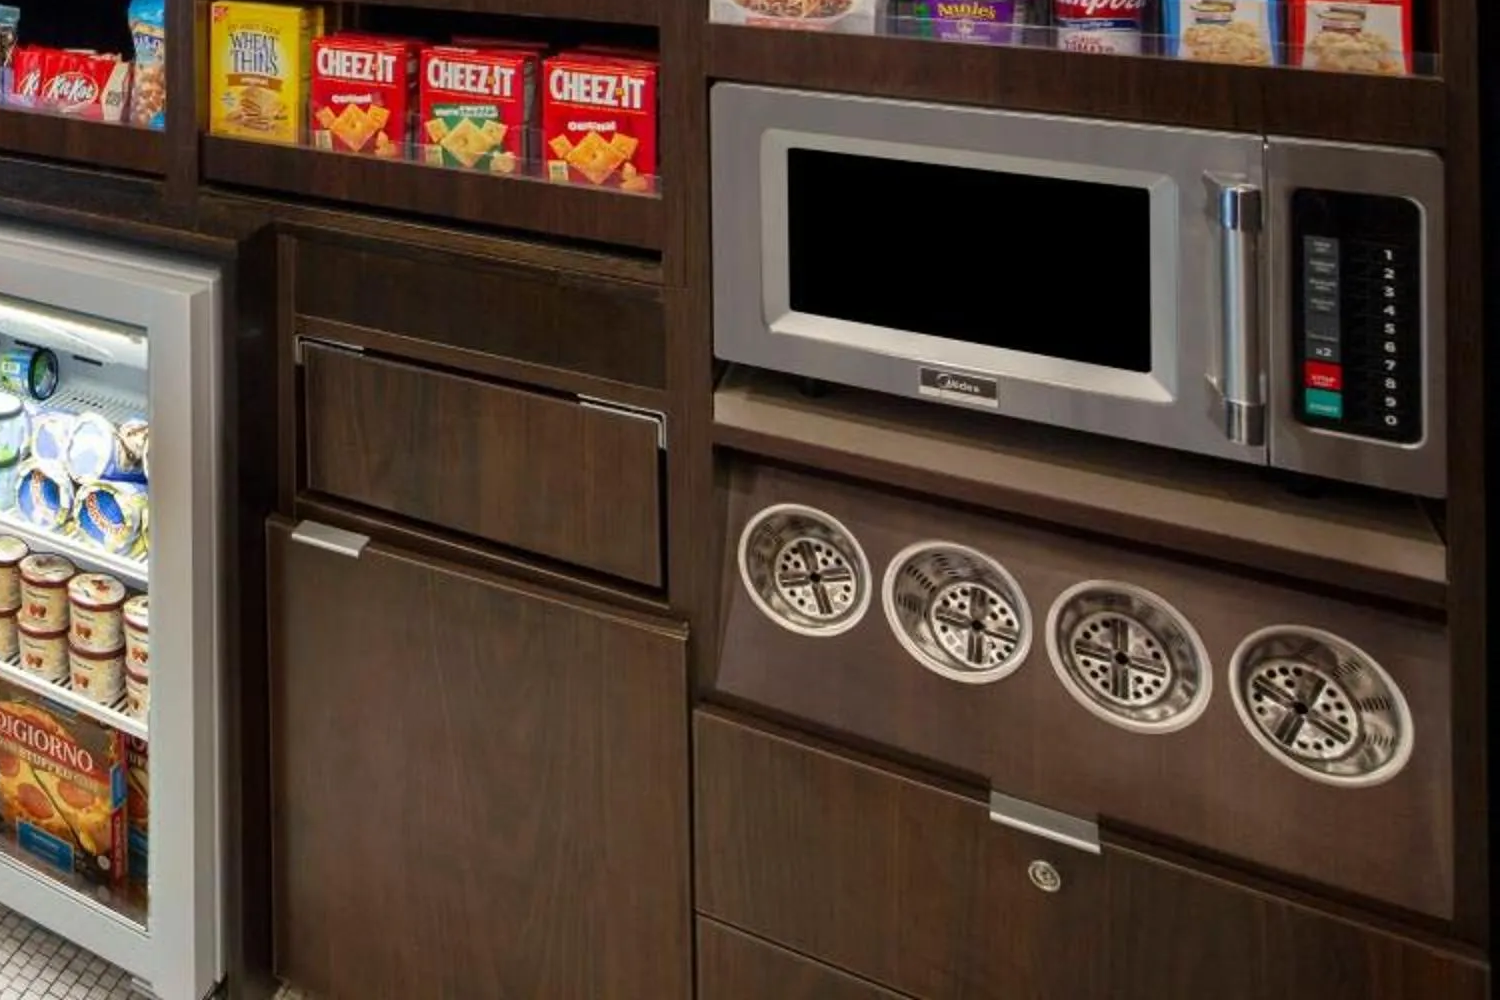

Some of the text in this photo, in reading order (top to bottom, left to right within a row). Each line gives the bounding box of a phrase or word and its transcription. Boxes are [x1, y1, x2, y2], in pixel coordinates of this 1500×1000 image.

[229, 31, 279, 50] WHEAT
[229, 47, 278, 76] THINS
[1384, 248, 1396, 260] 1
[1384, 267, 1396, 279] 2
[1384, 285, 1396, 297] 3
[1384, 304, 1396, 316] 4
[1384, 322, 1396, 334] 5
[1384, 341, 1396, 353] 6
[1384, 358, 1396, 370] 7
[1384, 377, 1396, 389] 8
[1384, 396, 1396, 408] 9
[1384, 414, 1396, 426] 0
